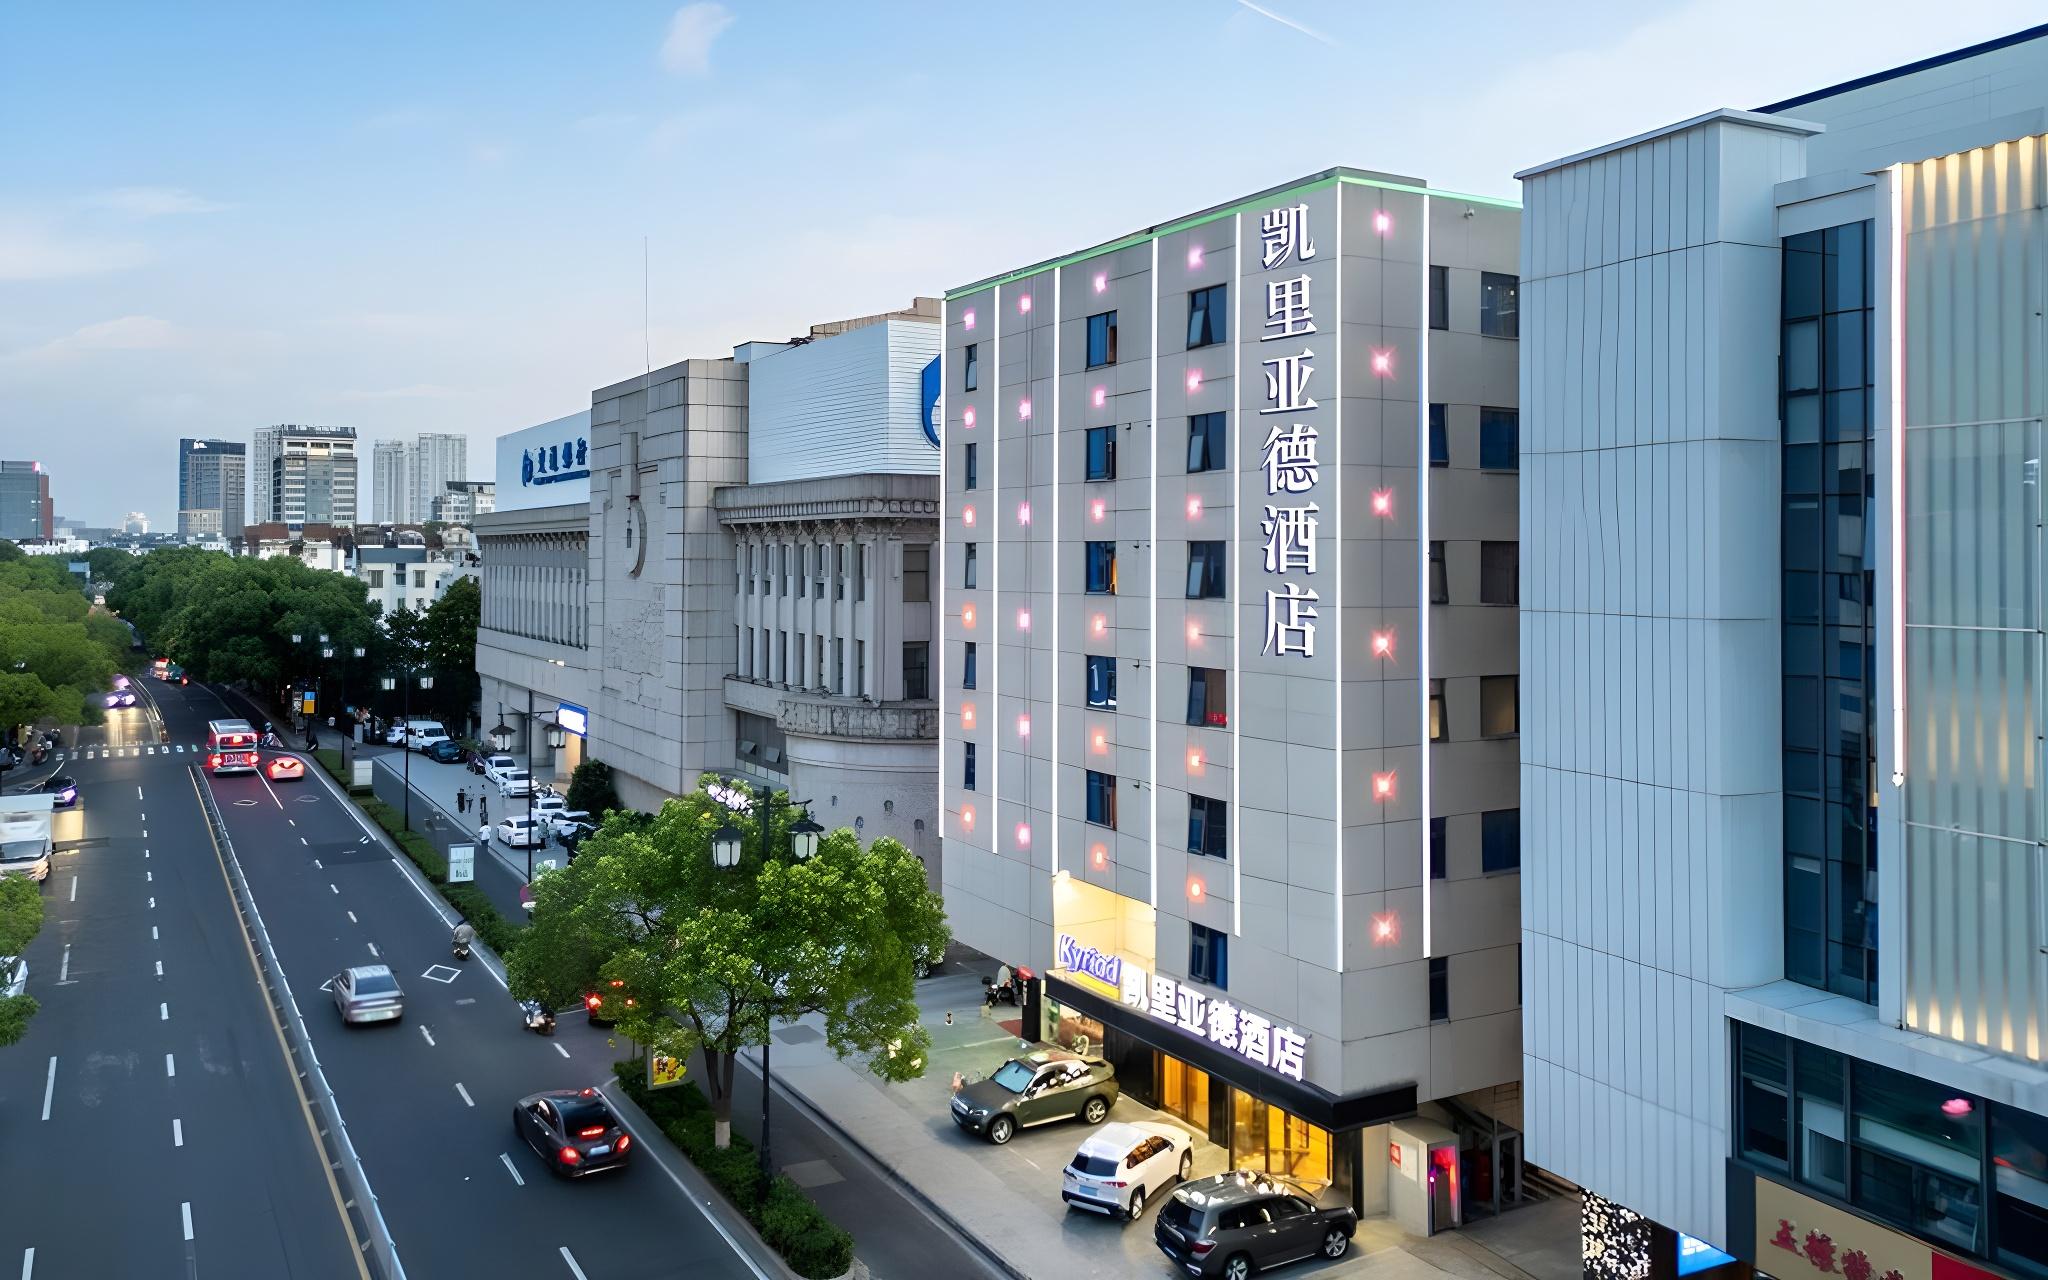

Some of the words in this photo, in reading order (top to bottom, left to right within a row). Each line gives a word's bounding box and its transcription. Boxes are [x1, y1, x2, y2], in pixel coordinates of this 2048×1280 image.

[1260, 203, 1319, 657] 凯里亚德酒店
[1059, 934, 1121, 985] Kyriad
[1121, 962, 1307, 1081] 凯里亚德酒店
